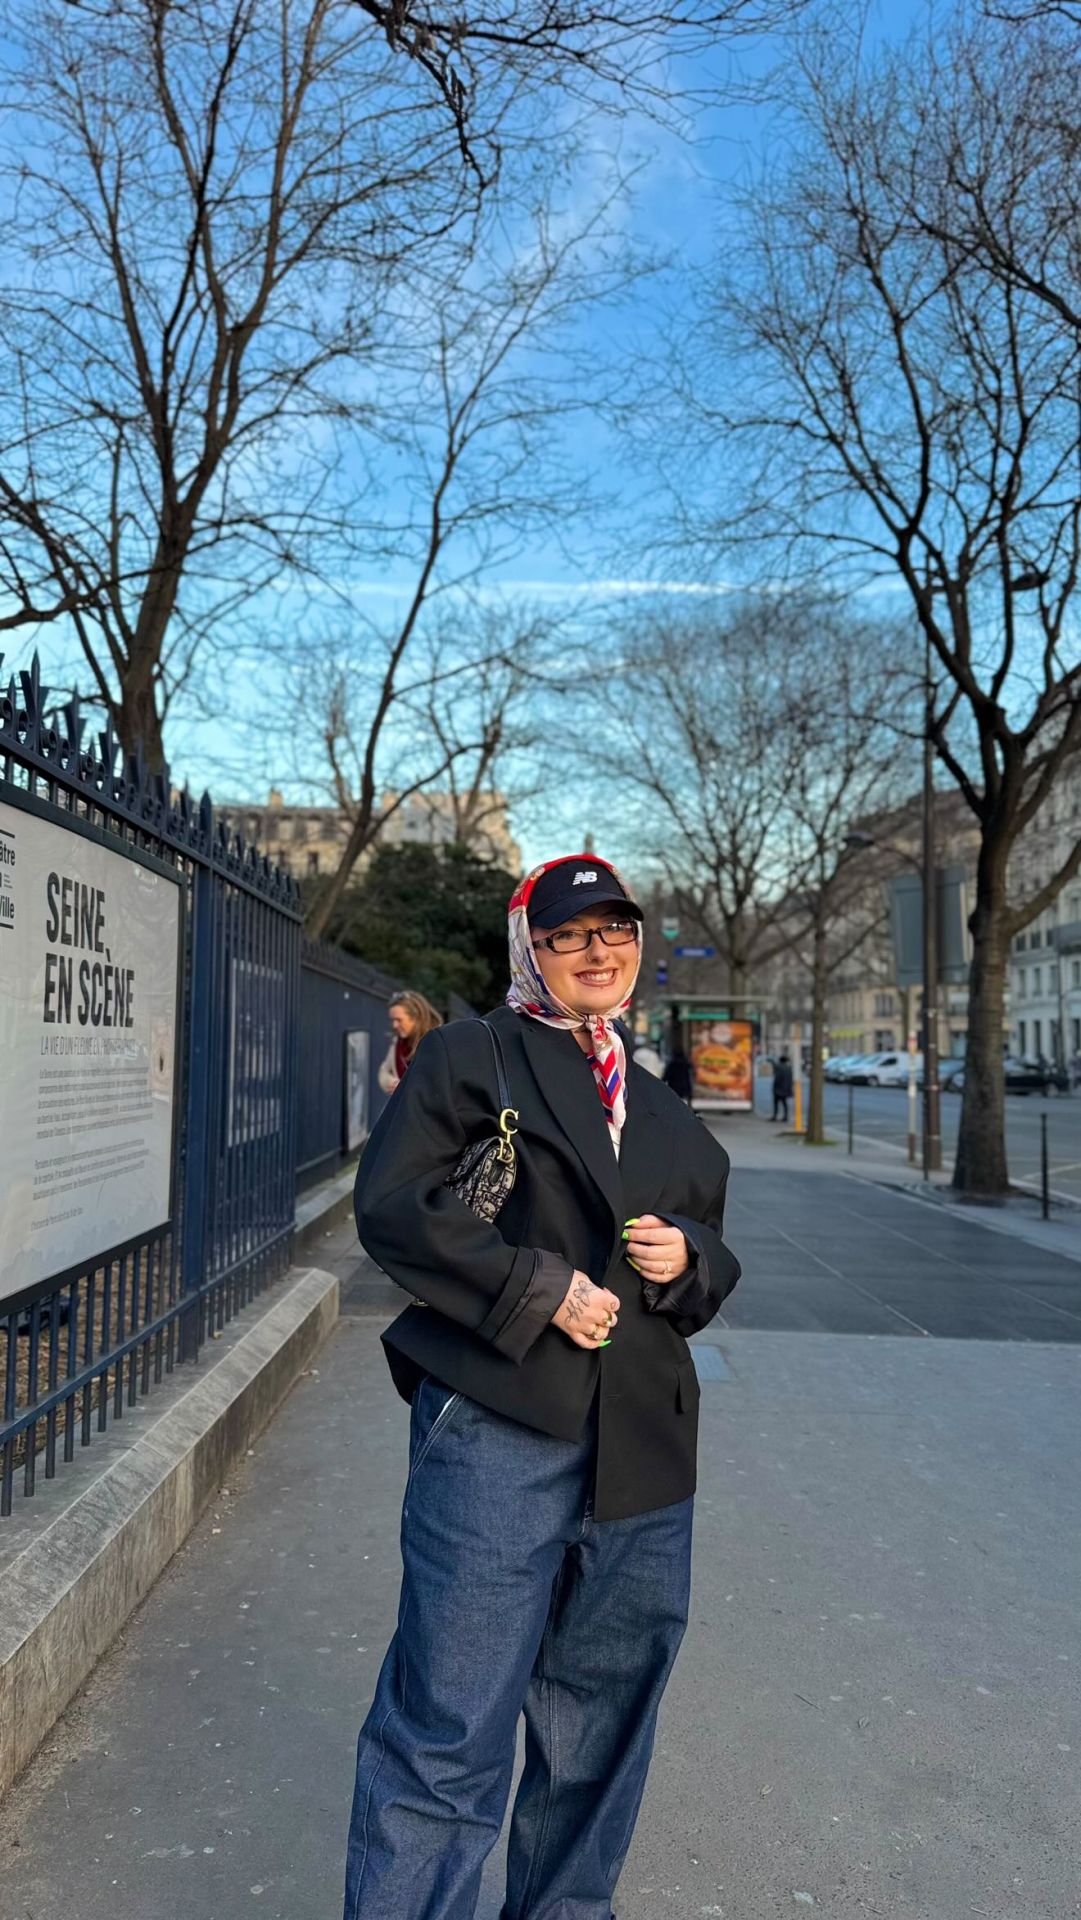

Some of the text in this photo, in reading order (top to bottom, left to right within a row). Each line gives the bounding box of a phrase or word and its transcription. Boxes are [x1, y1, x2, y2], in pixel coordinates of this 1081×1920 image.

[46, 871, 105, 953] SEINE
[43, 948, 135, 1028] EN SCÈNE
